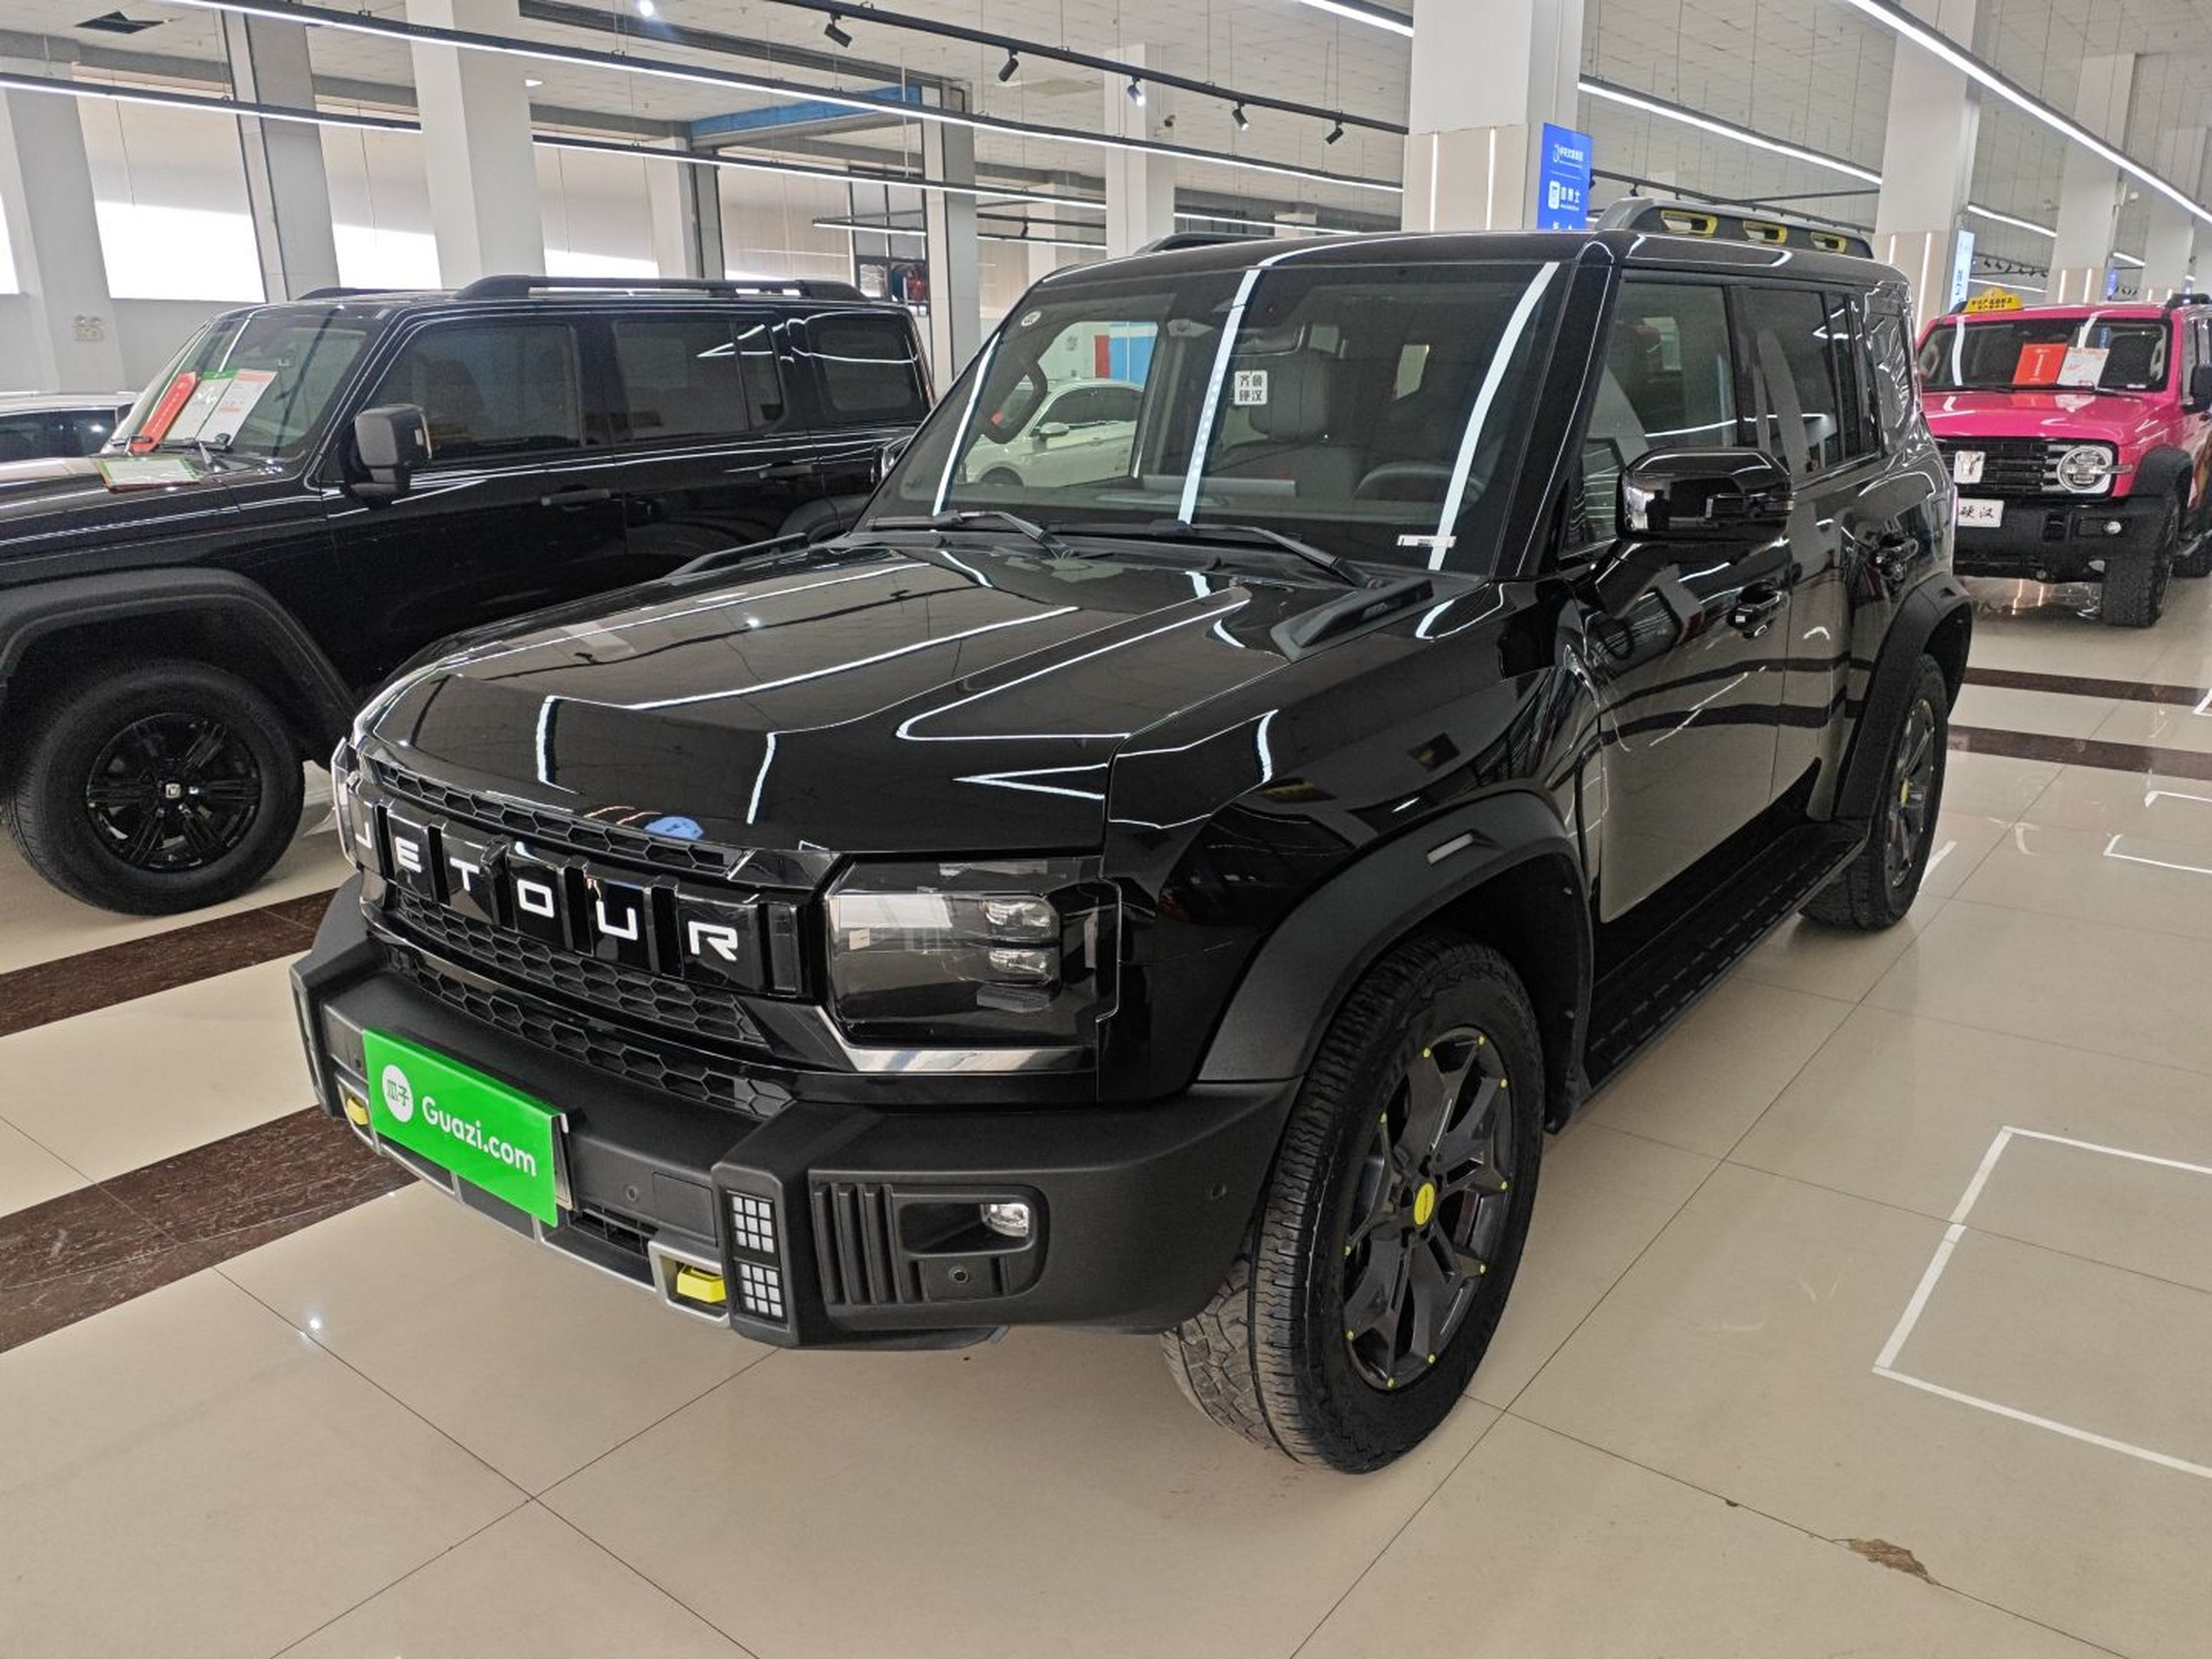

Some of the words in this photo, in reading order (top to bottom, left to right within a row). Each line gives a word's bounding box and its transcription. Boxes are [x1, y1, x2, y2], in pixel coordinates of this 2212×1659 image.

[355, 822, 738, 961] JETOUR
[386, 1079, 409, 1109] 瓜子
[422, 1096, 537, 1177] Guazi.com
